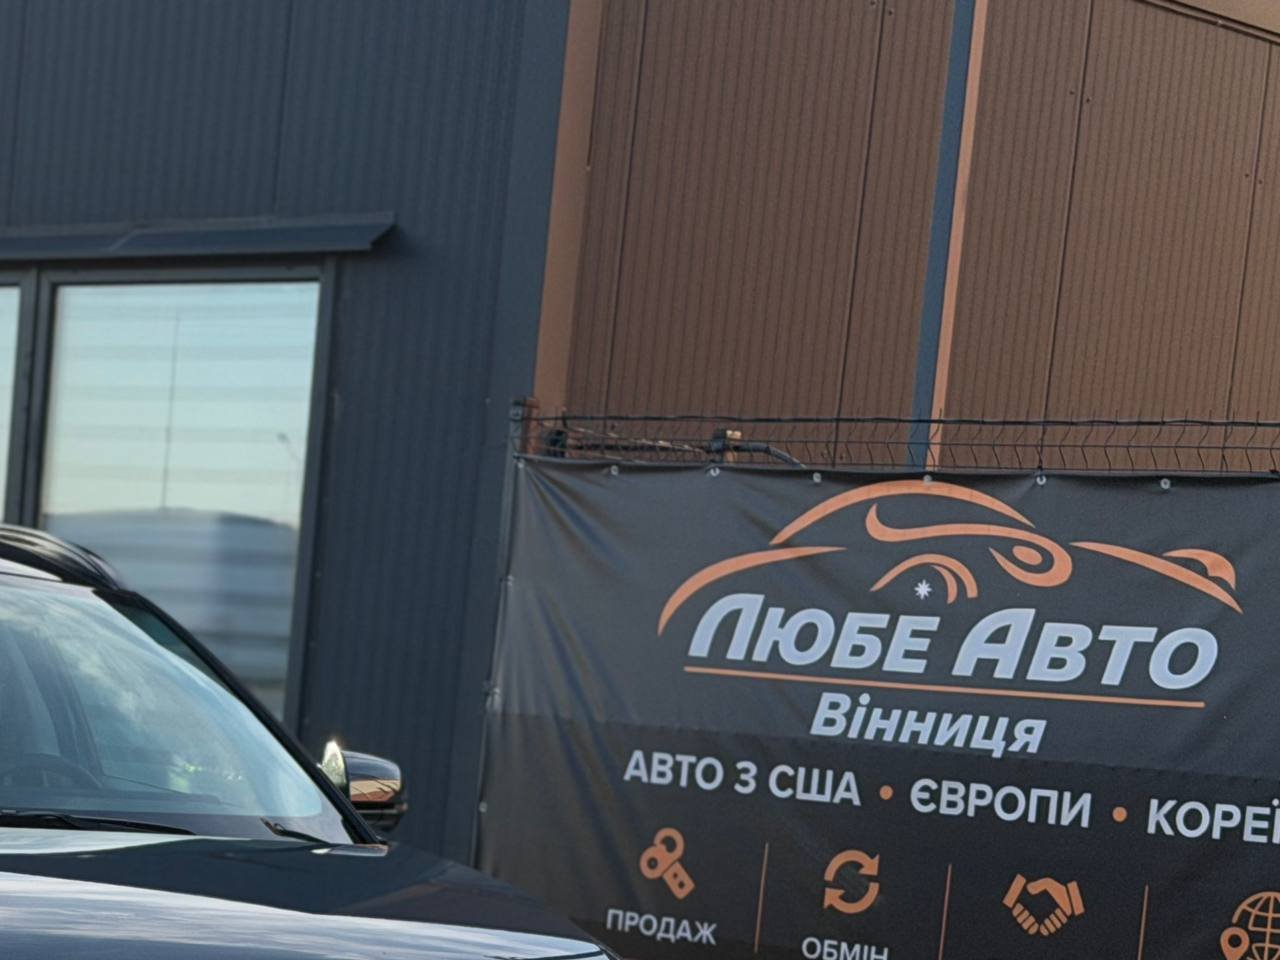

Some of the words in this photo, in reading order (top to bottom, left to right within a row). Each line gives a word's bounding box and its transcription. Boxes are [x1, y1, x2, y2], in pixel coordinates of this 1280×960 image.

[809, 691, 1048, 759] Вінниця
[623, 749, 724, 791] АВТО
[733, 760, 758, 795] З
[768, 764, 861, 806] США
[910, 778, 1092, 828] ЄВРОПИ
[606, 908, 717, 945] ПРОДАЖ
